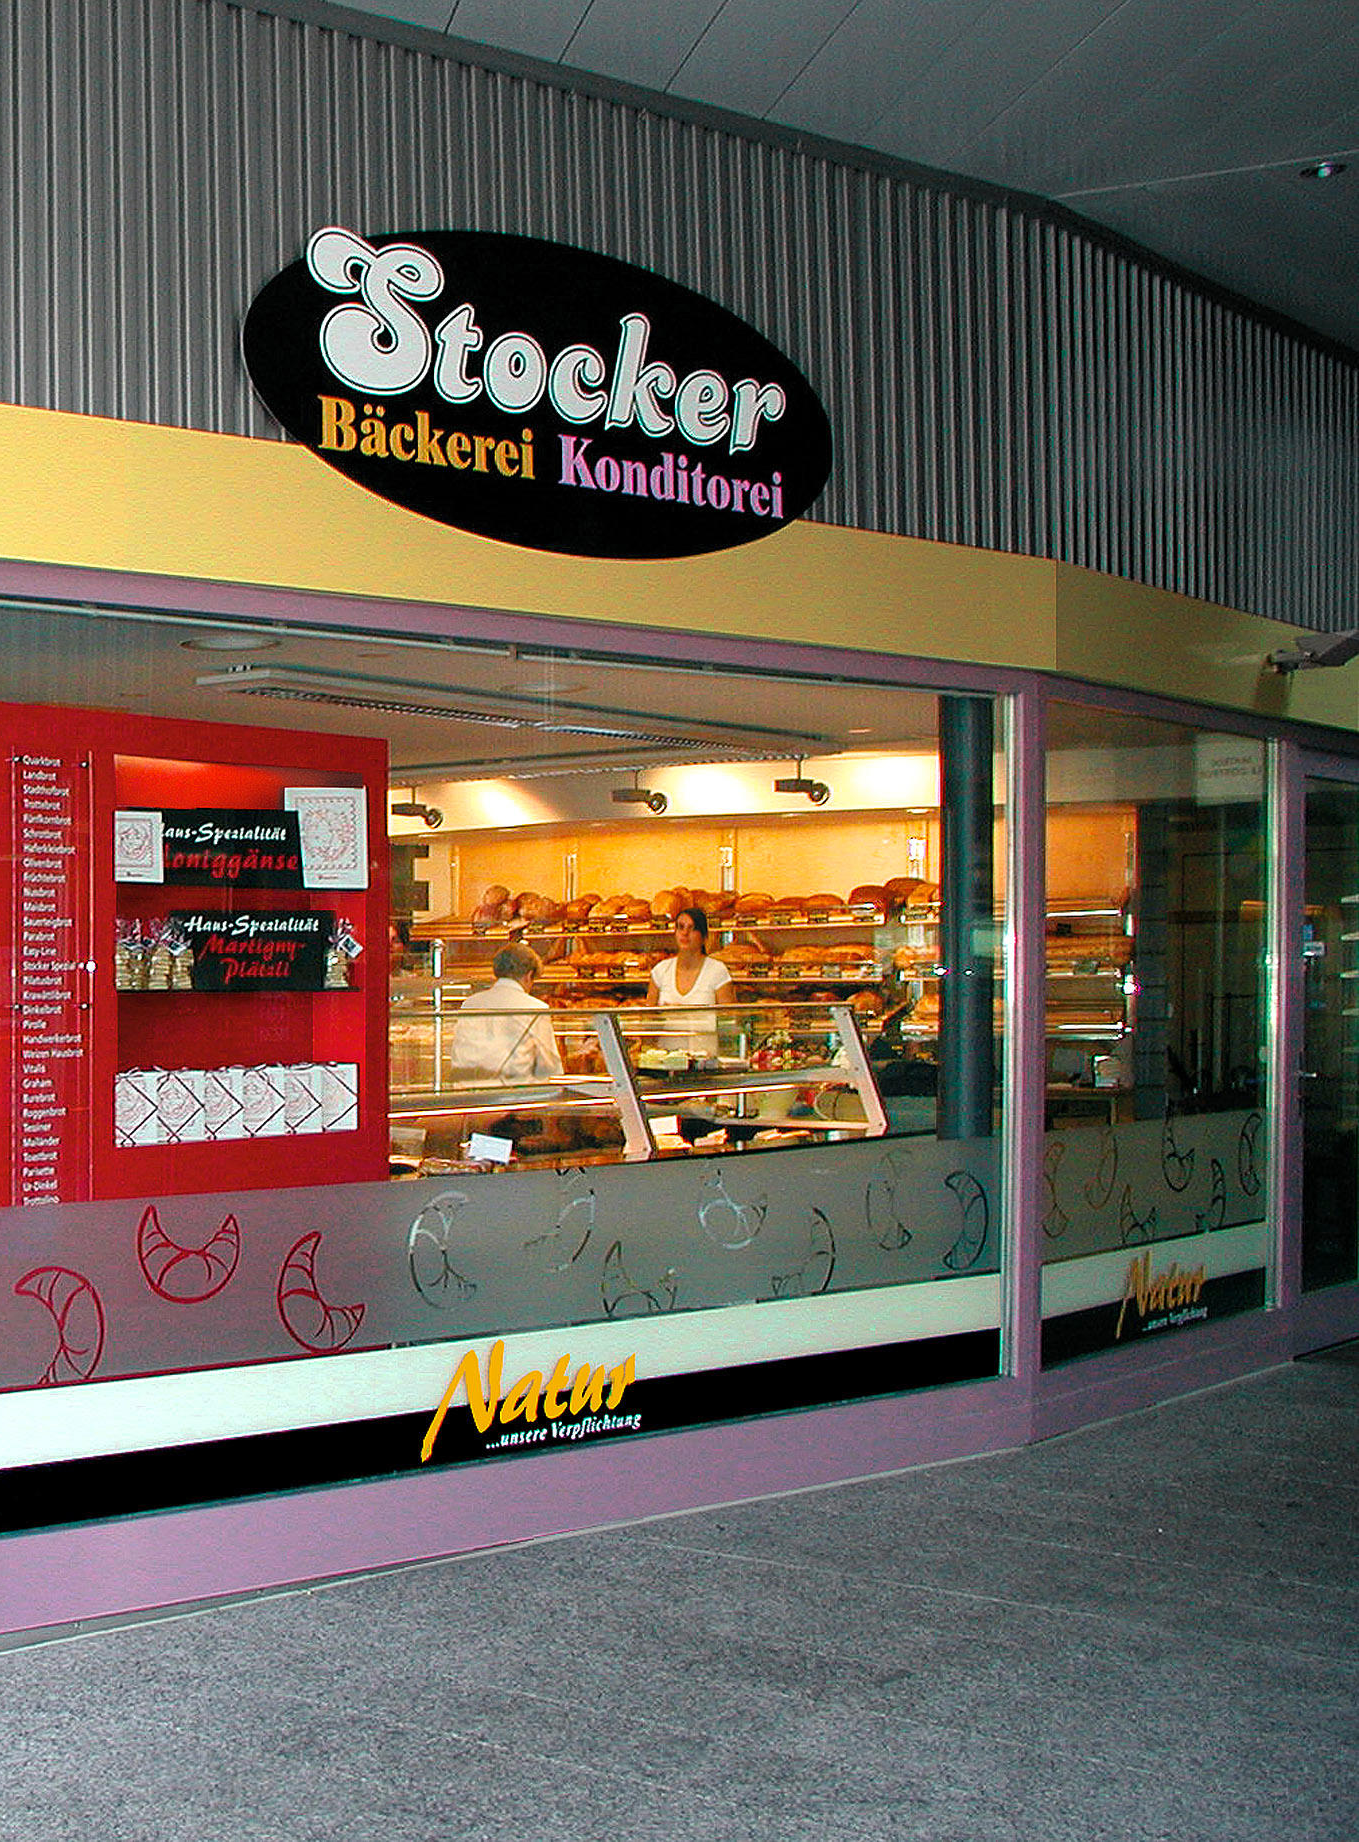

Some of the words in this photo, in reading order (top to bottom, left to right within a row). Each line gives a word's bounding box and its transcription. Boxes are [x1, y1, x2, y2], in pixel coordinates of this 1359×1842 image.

[307, 226, 786, 456] Stocker
[317, 393, 536, 481] Bäckerei
[558, 434, 784, 520] Konditorei
[183, 915, 320, 937] Haus-Spezialität
[421, 1339, 636, 1463] Natur
[551, 1413, 641, 1441] Verpflichtung
